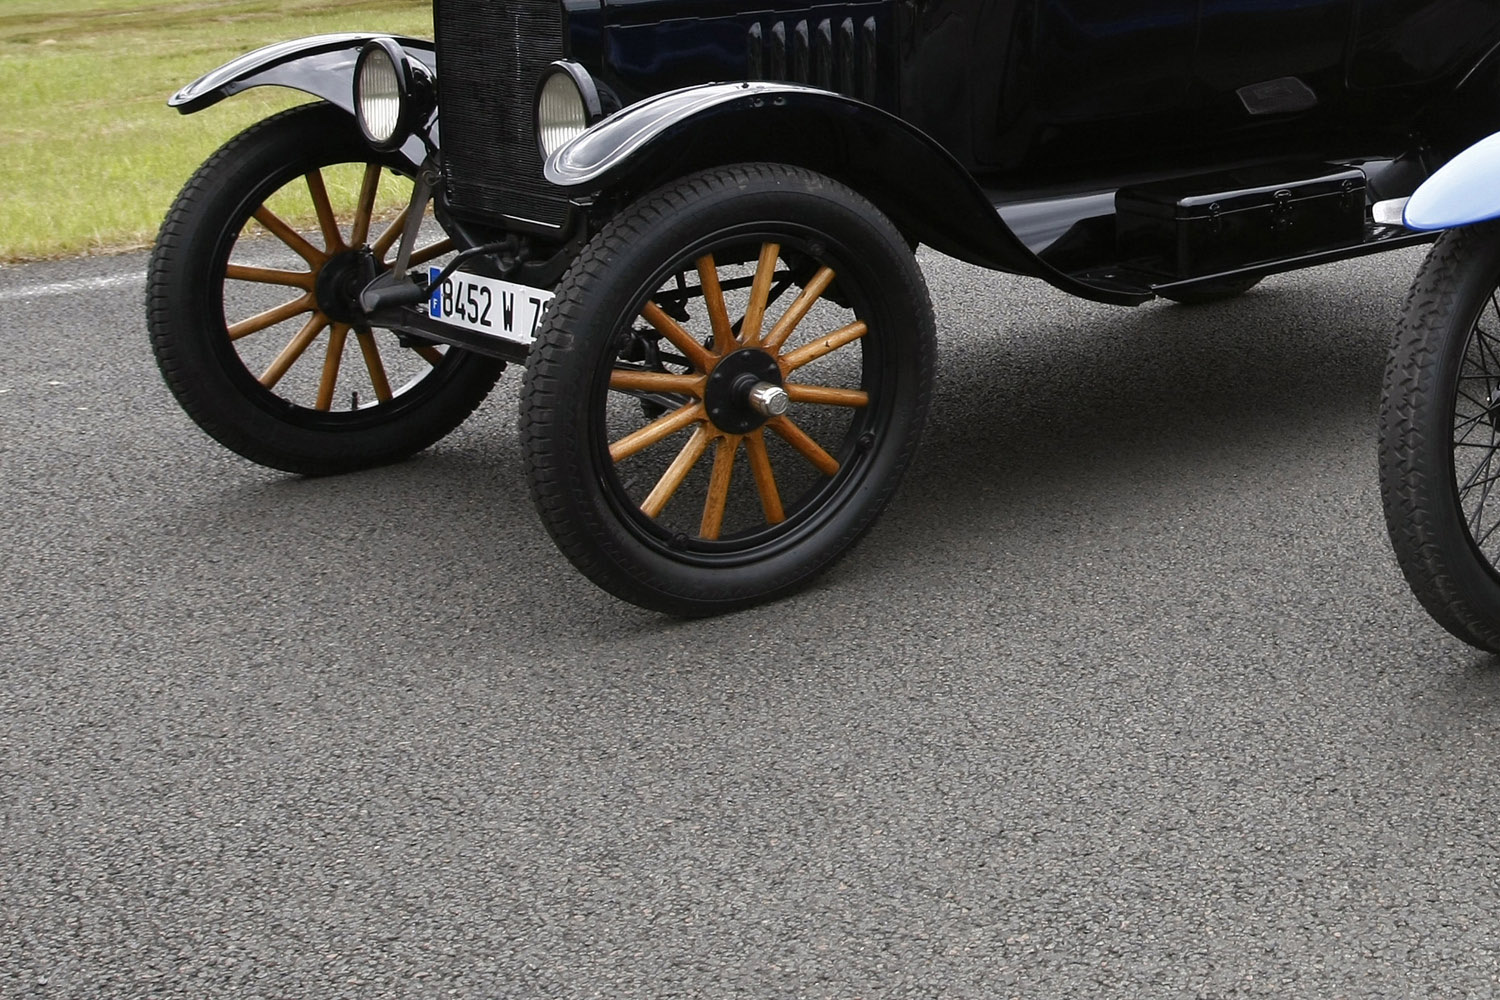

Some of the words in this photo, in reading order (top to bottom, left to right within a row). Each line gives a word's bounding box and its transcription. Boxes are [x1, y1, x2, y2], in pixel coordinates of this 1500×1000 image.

[432, 298, 439, 309] F
[442, 277, 492, 327] 8452
[502, 290, 515, 332] W
[528, 297, 550, 338] 7
